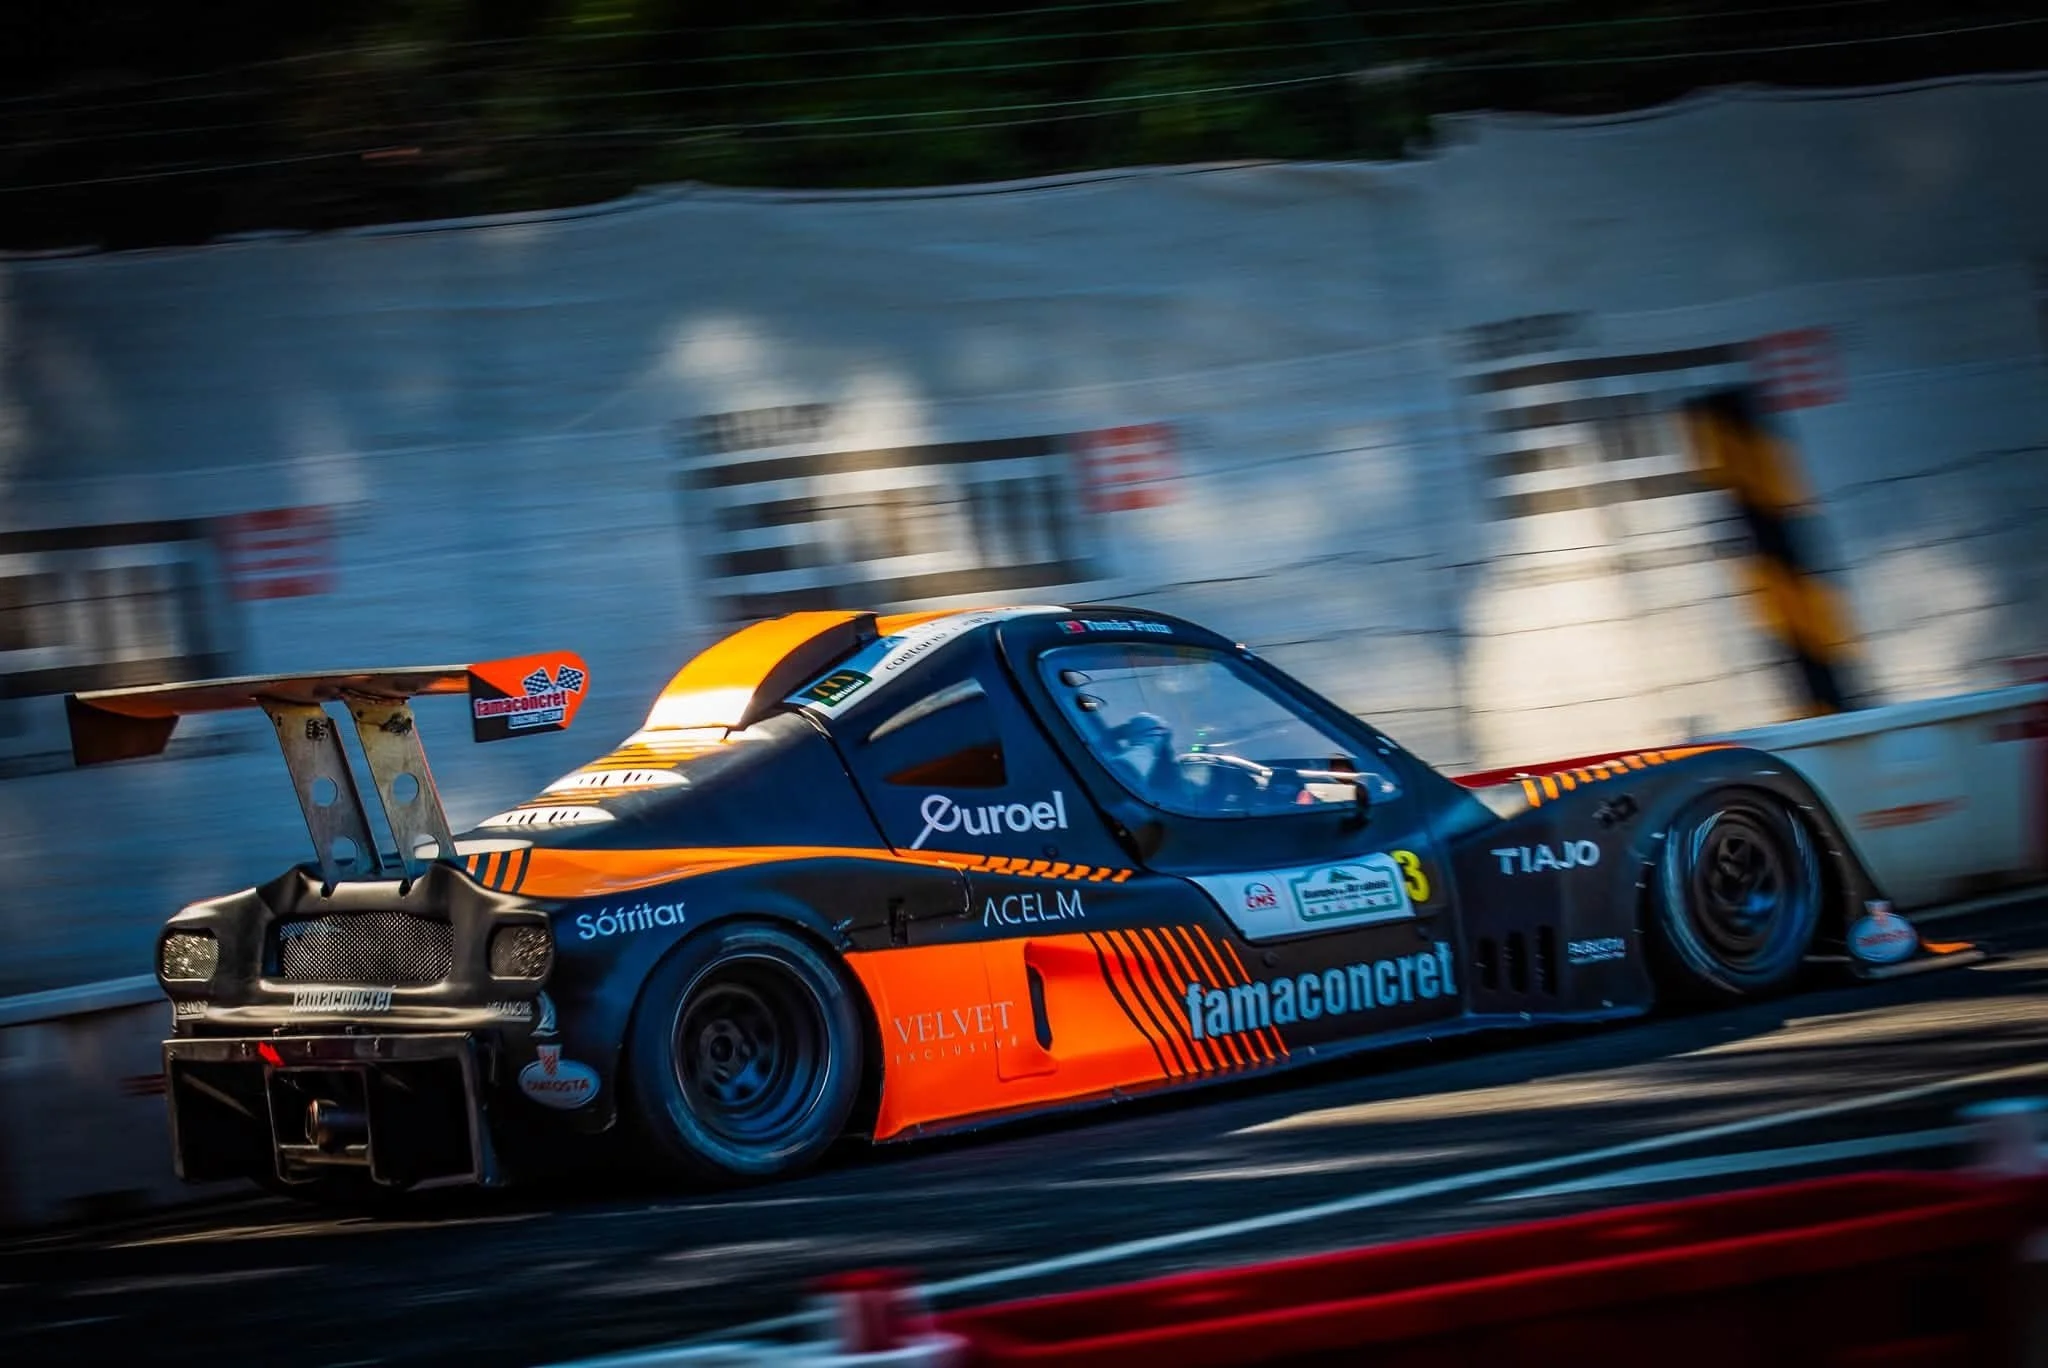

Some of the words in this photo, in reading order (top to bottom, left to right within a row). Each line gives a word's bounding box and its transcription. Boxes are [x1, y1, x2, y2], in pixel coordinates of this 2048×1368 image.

[476, 690, 567, 716] famaconcret
[1391, 850, 1430, 902] 3
[1491, 840, 1599, 875] TIAJO
[576, 902, 685, 939] Sófritar
[983, 889, 1085, 927] ACELM
[1185, 941, 1457, 1040] famaconcret
[894, 1001, 1014, 1044] VELVET
